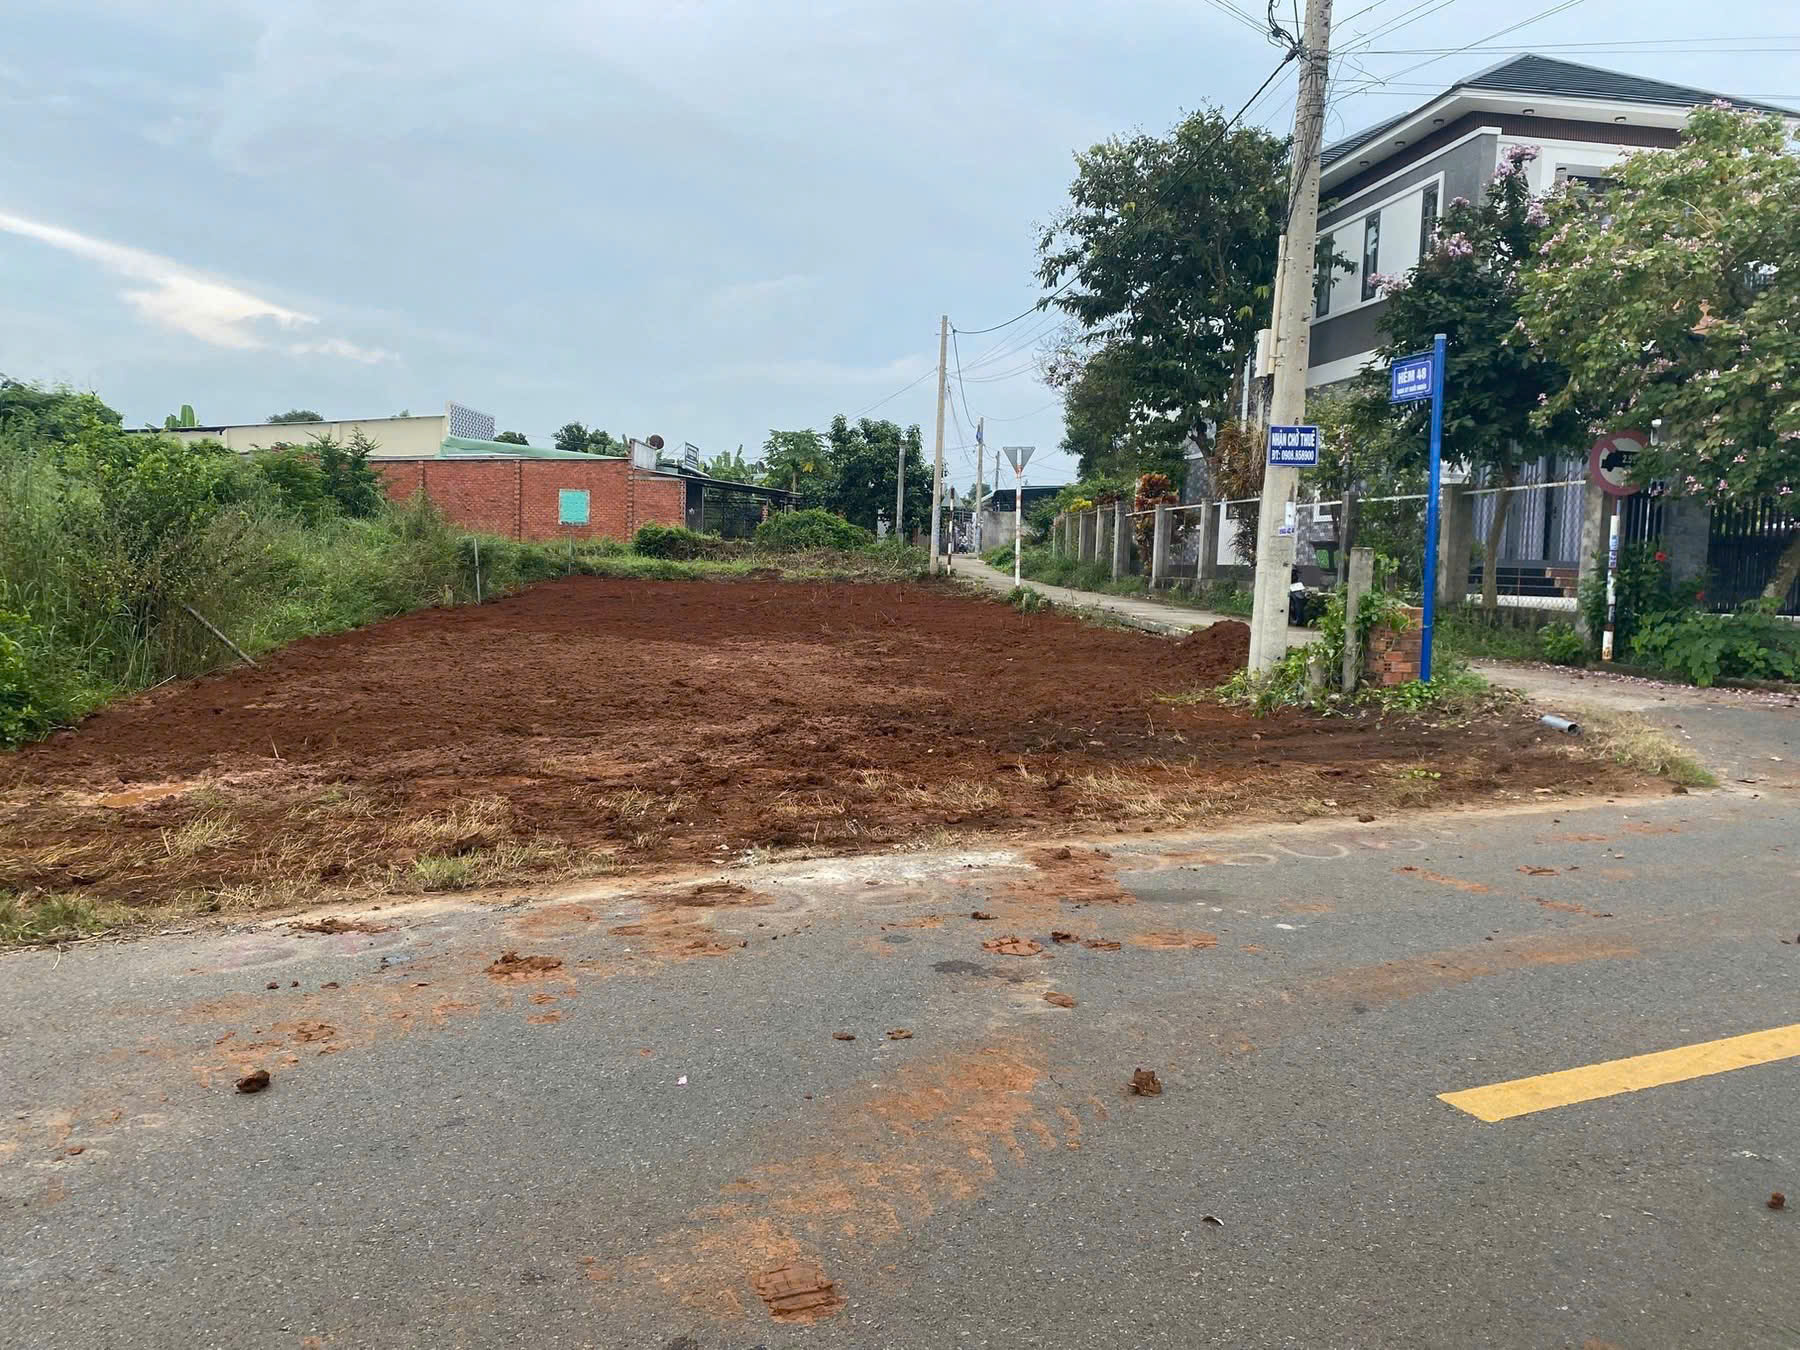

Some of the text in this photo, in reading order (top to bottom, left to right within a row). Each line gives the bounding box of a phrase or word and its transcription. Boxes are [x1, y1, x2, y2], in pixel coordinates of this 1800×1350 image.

[1271, 428, 1316, 449] NHẬN CHỞ THUÊ
